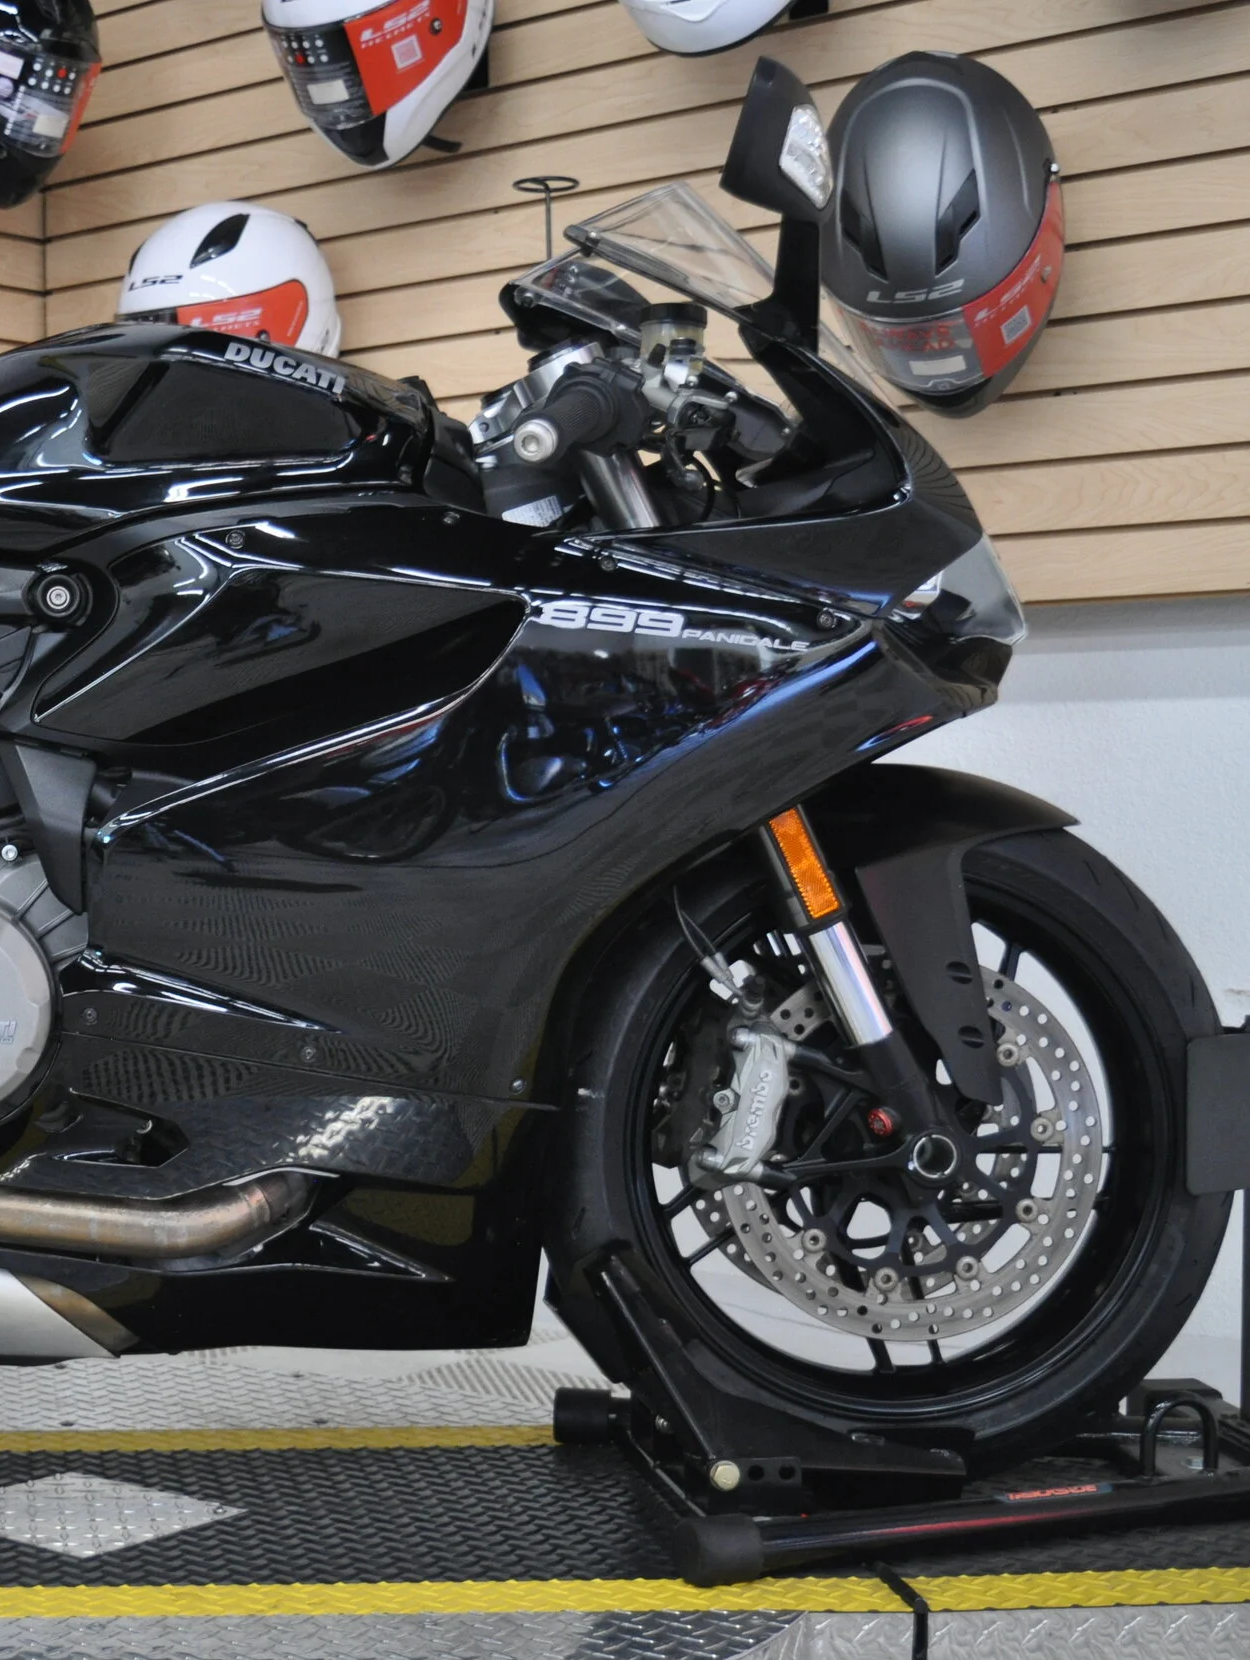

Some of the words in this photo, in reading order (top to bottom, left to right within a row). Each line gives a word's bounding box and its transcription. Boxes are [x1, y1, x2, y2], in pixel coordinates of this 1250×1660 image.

[128, 274, 183, 292] LS2
[866, 279, 965, 303] LS2
[224, 342, 346, 394] DUCATI
[541, 601, 685, 638] 899
[736, 1069, 772, 1152] brembo
